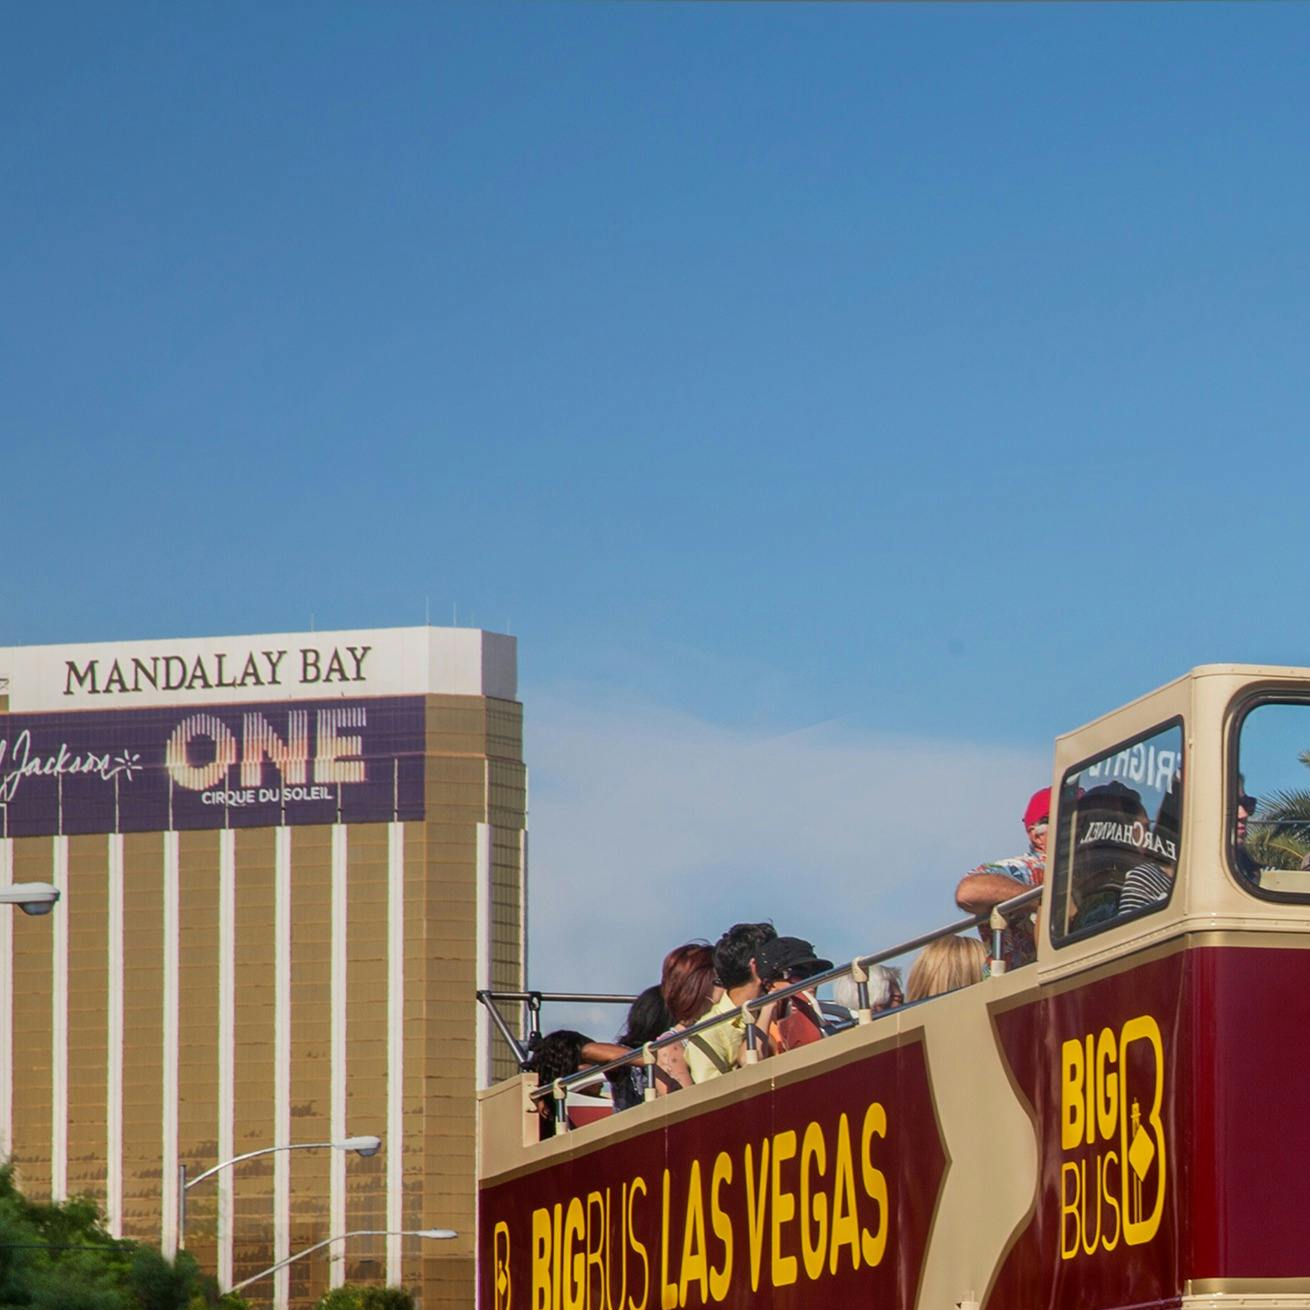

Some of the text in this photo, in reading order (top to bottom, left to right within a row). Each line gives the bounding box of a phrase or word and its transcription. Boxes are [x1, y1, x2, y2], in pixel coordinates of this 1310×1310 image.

[63, 646, 372, 695] MANDALAY BAY
[3, 729, 114, 802] Jackson
[165, 707, 367, 791] ONE
[201, 786, 333, 807] CIRQUE DU SOLEIL
[1061, 1026, 1118, 1150] BIG
[744, 1102, 889, 1293] VEGAS
[1061, 1150, 1120, 1260] BUS
